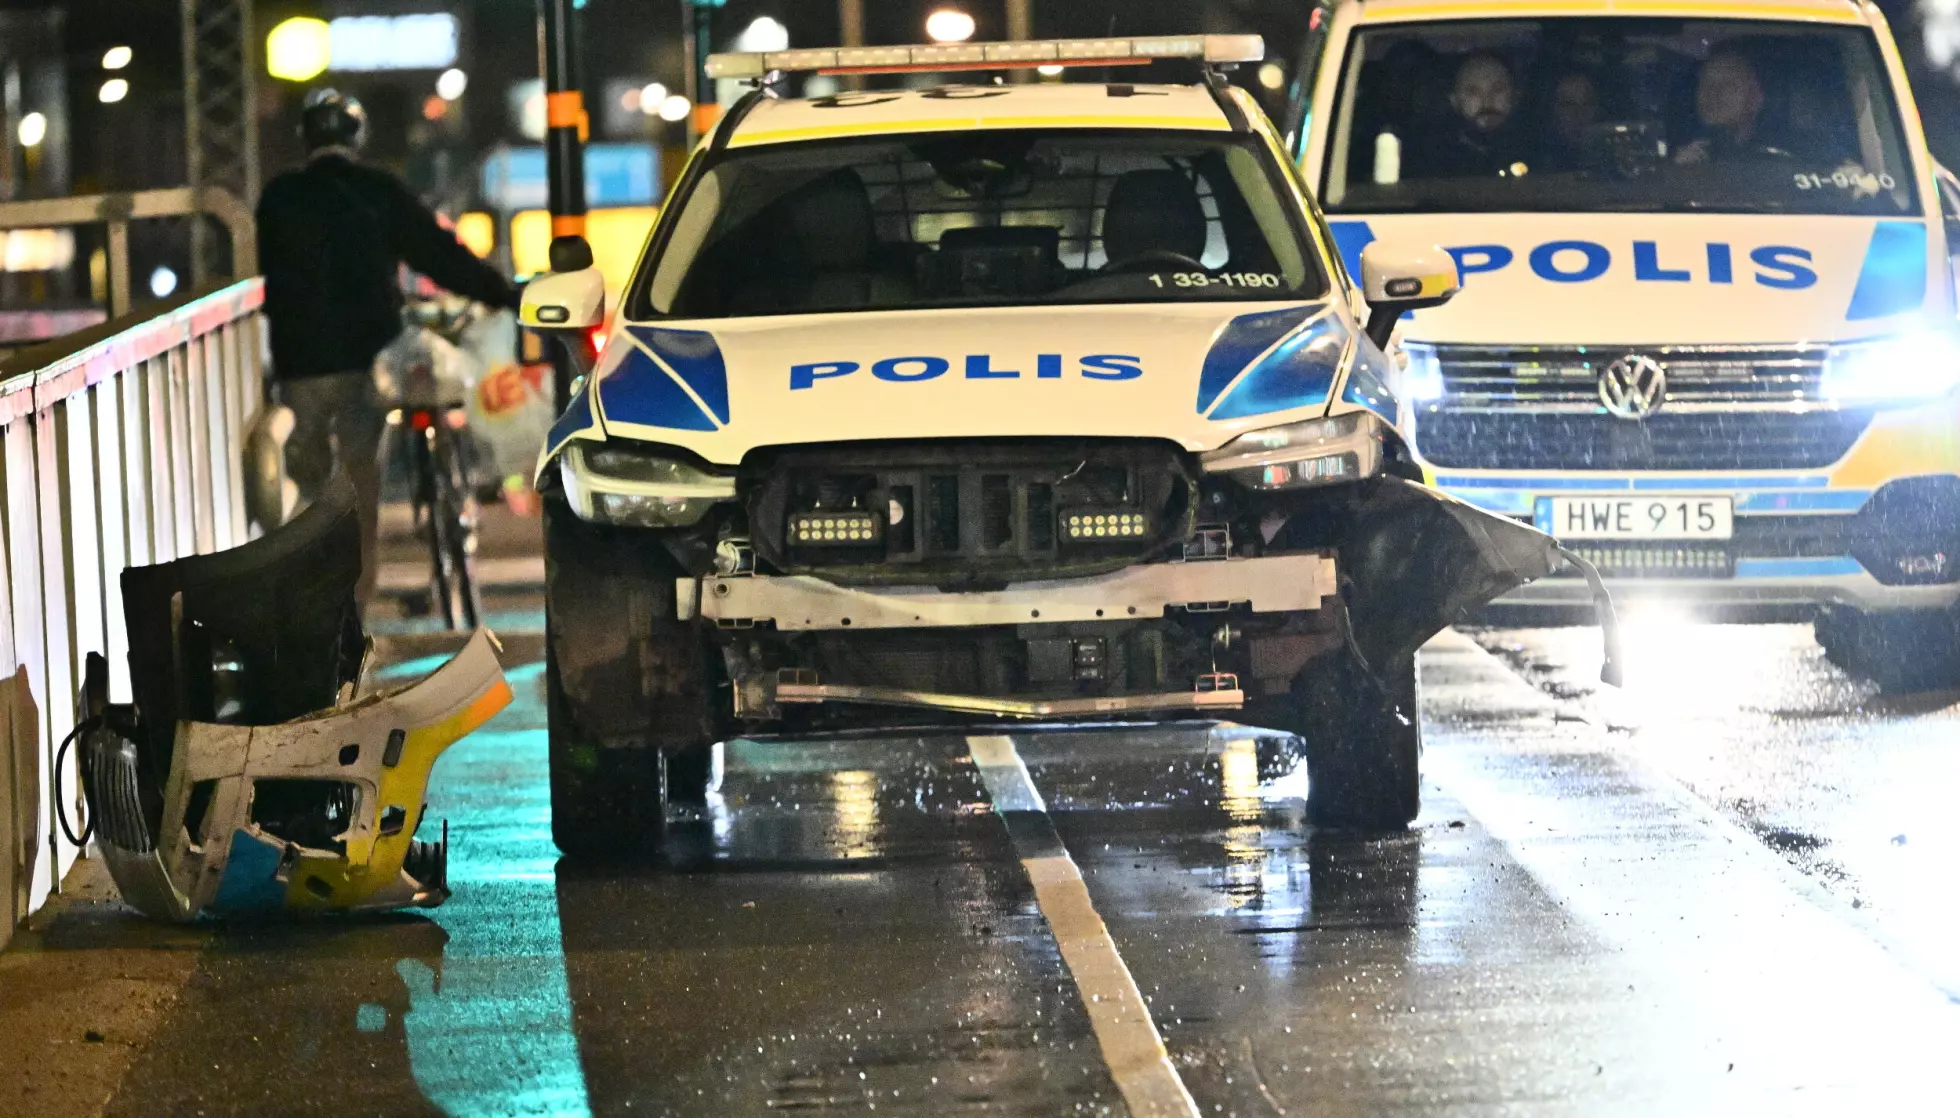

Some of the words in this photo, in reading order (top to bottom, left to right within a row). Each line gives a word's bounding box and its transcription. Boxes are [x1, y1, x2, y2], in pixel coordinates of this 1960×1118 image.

[1149, 273, 1164, 288] 1
[1172, 272, 1279, 288] 33-1190
[1444, 240, 1819, 290] POLIS
[789, 354, 1143, 390] POLIS
[1568, 502, 1633, 532] HWE
[1648, 502, 1715, 532] 915
